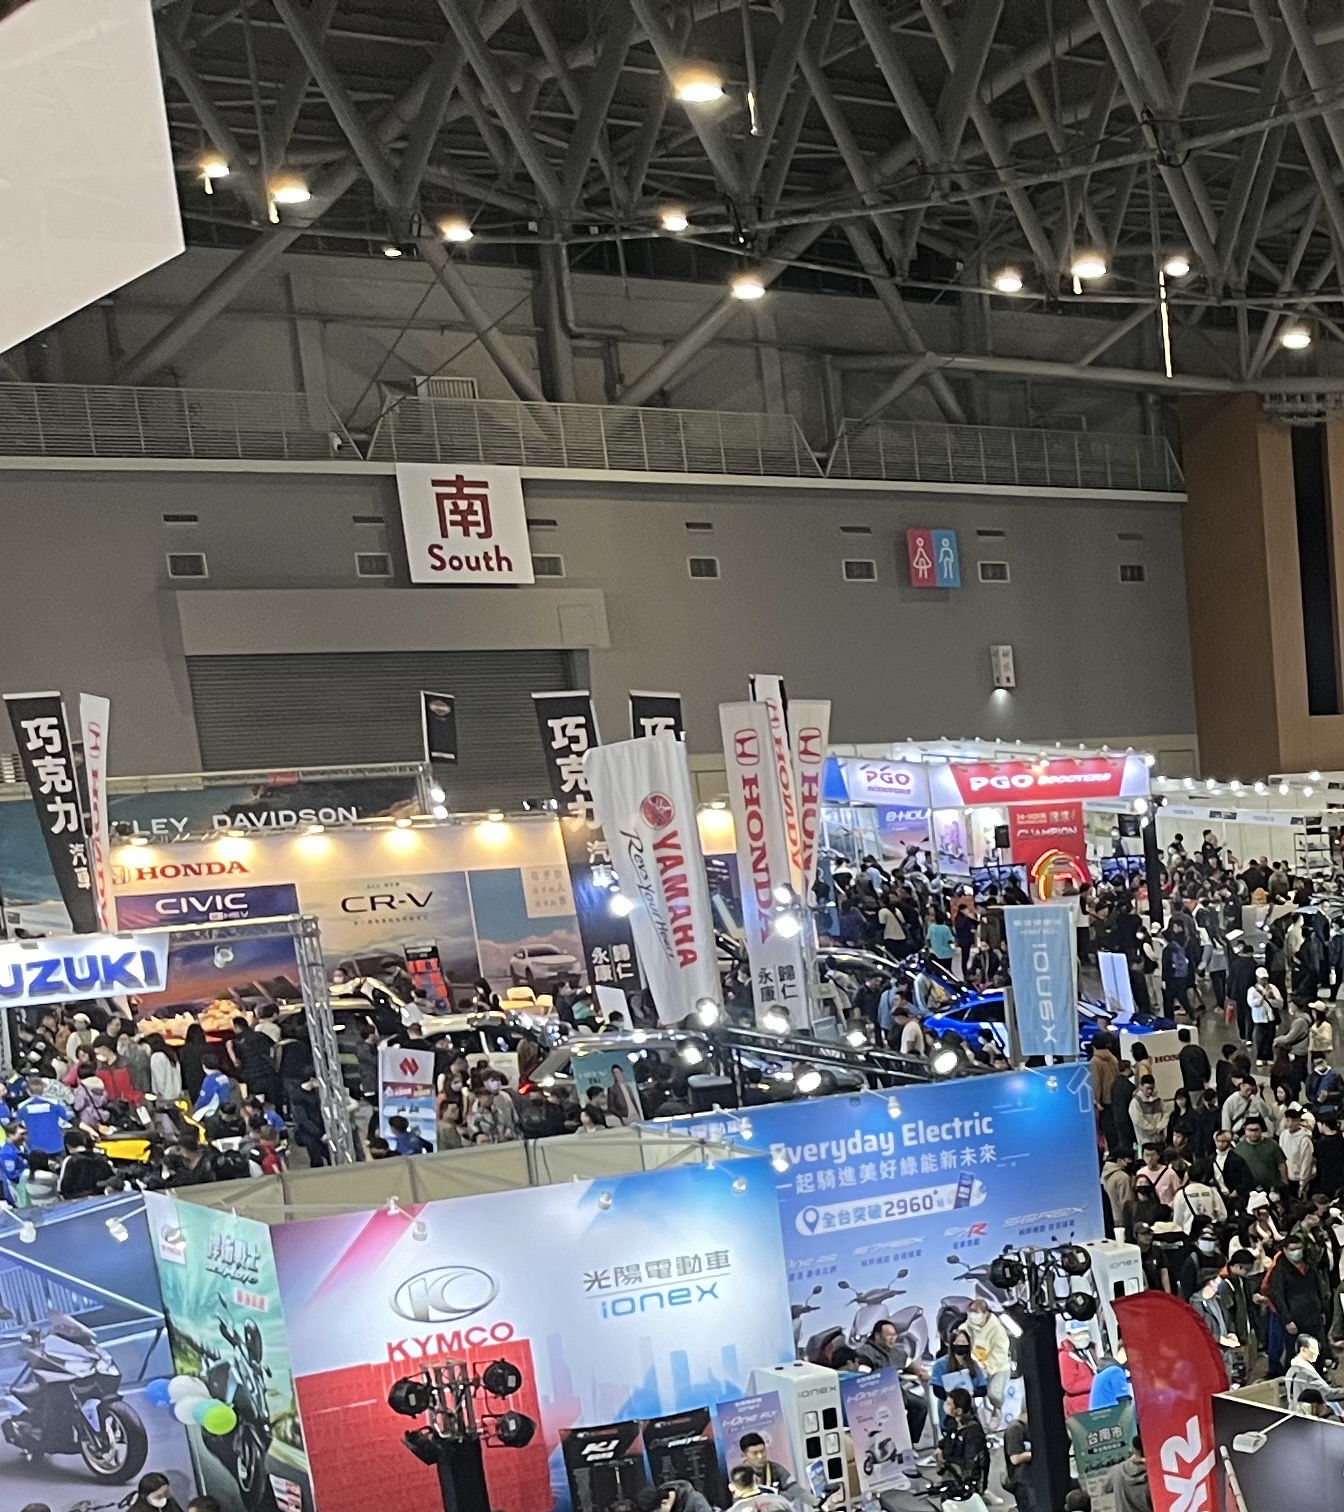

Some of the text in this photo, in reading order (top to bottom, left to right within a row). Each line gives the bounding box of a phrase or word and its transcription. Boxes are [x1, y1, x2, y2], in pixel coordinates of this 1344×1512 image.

[431, 474, 493, 540] 南
[427, 543, 514, 574] South
[20, 716, 80, 835] 巧克力
[866, 771, 911, 787] PGO
[969, 773, 1034, 792] PGO
[211, 805, 359, 831] DAVIDSON
[135, 860, 249, 881] HONDA
[741, 772, 776, 945] HONDA
[155, 892, 249, 915] CIVIC
[340, 891, 434, 914] CR-V
[652, 829, 699, 969] YAMAHA
[1154, 1052, 1181, 1064] HON
[769, 1111, 994, 1165] Everyday Electric
[583, 1249, 732, 1292] 光陽電動車
[601, 1281, 720, 1319] ionex
[386, 1322, 515, 1363] KYMCO
[1087, 1425, 1123, 1445] 台南市
